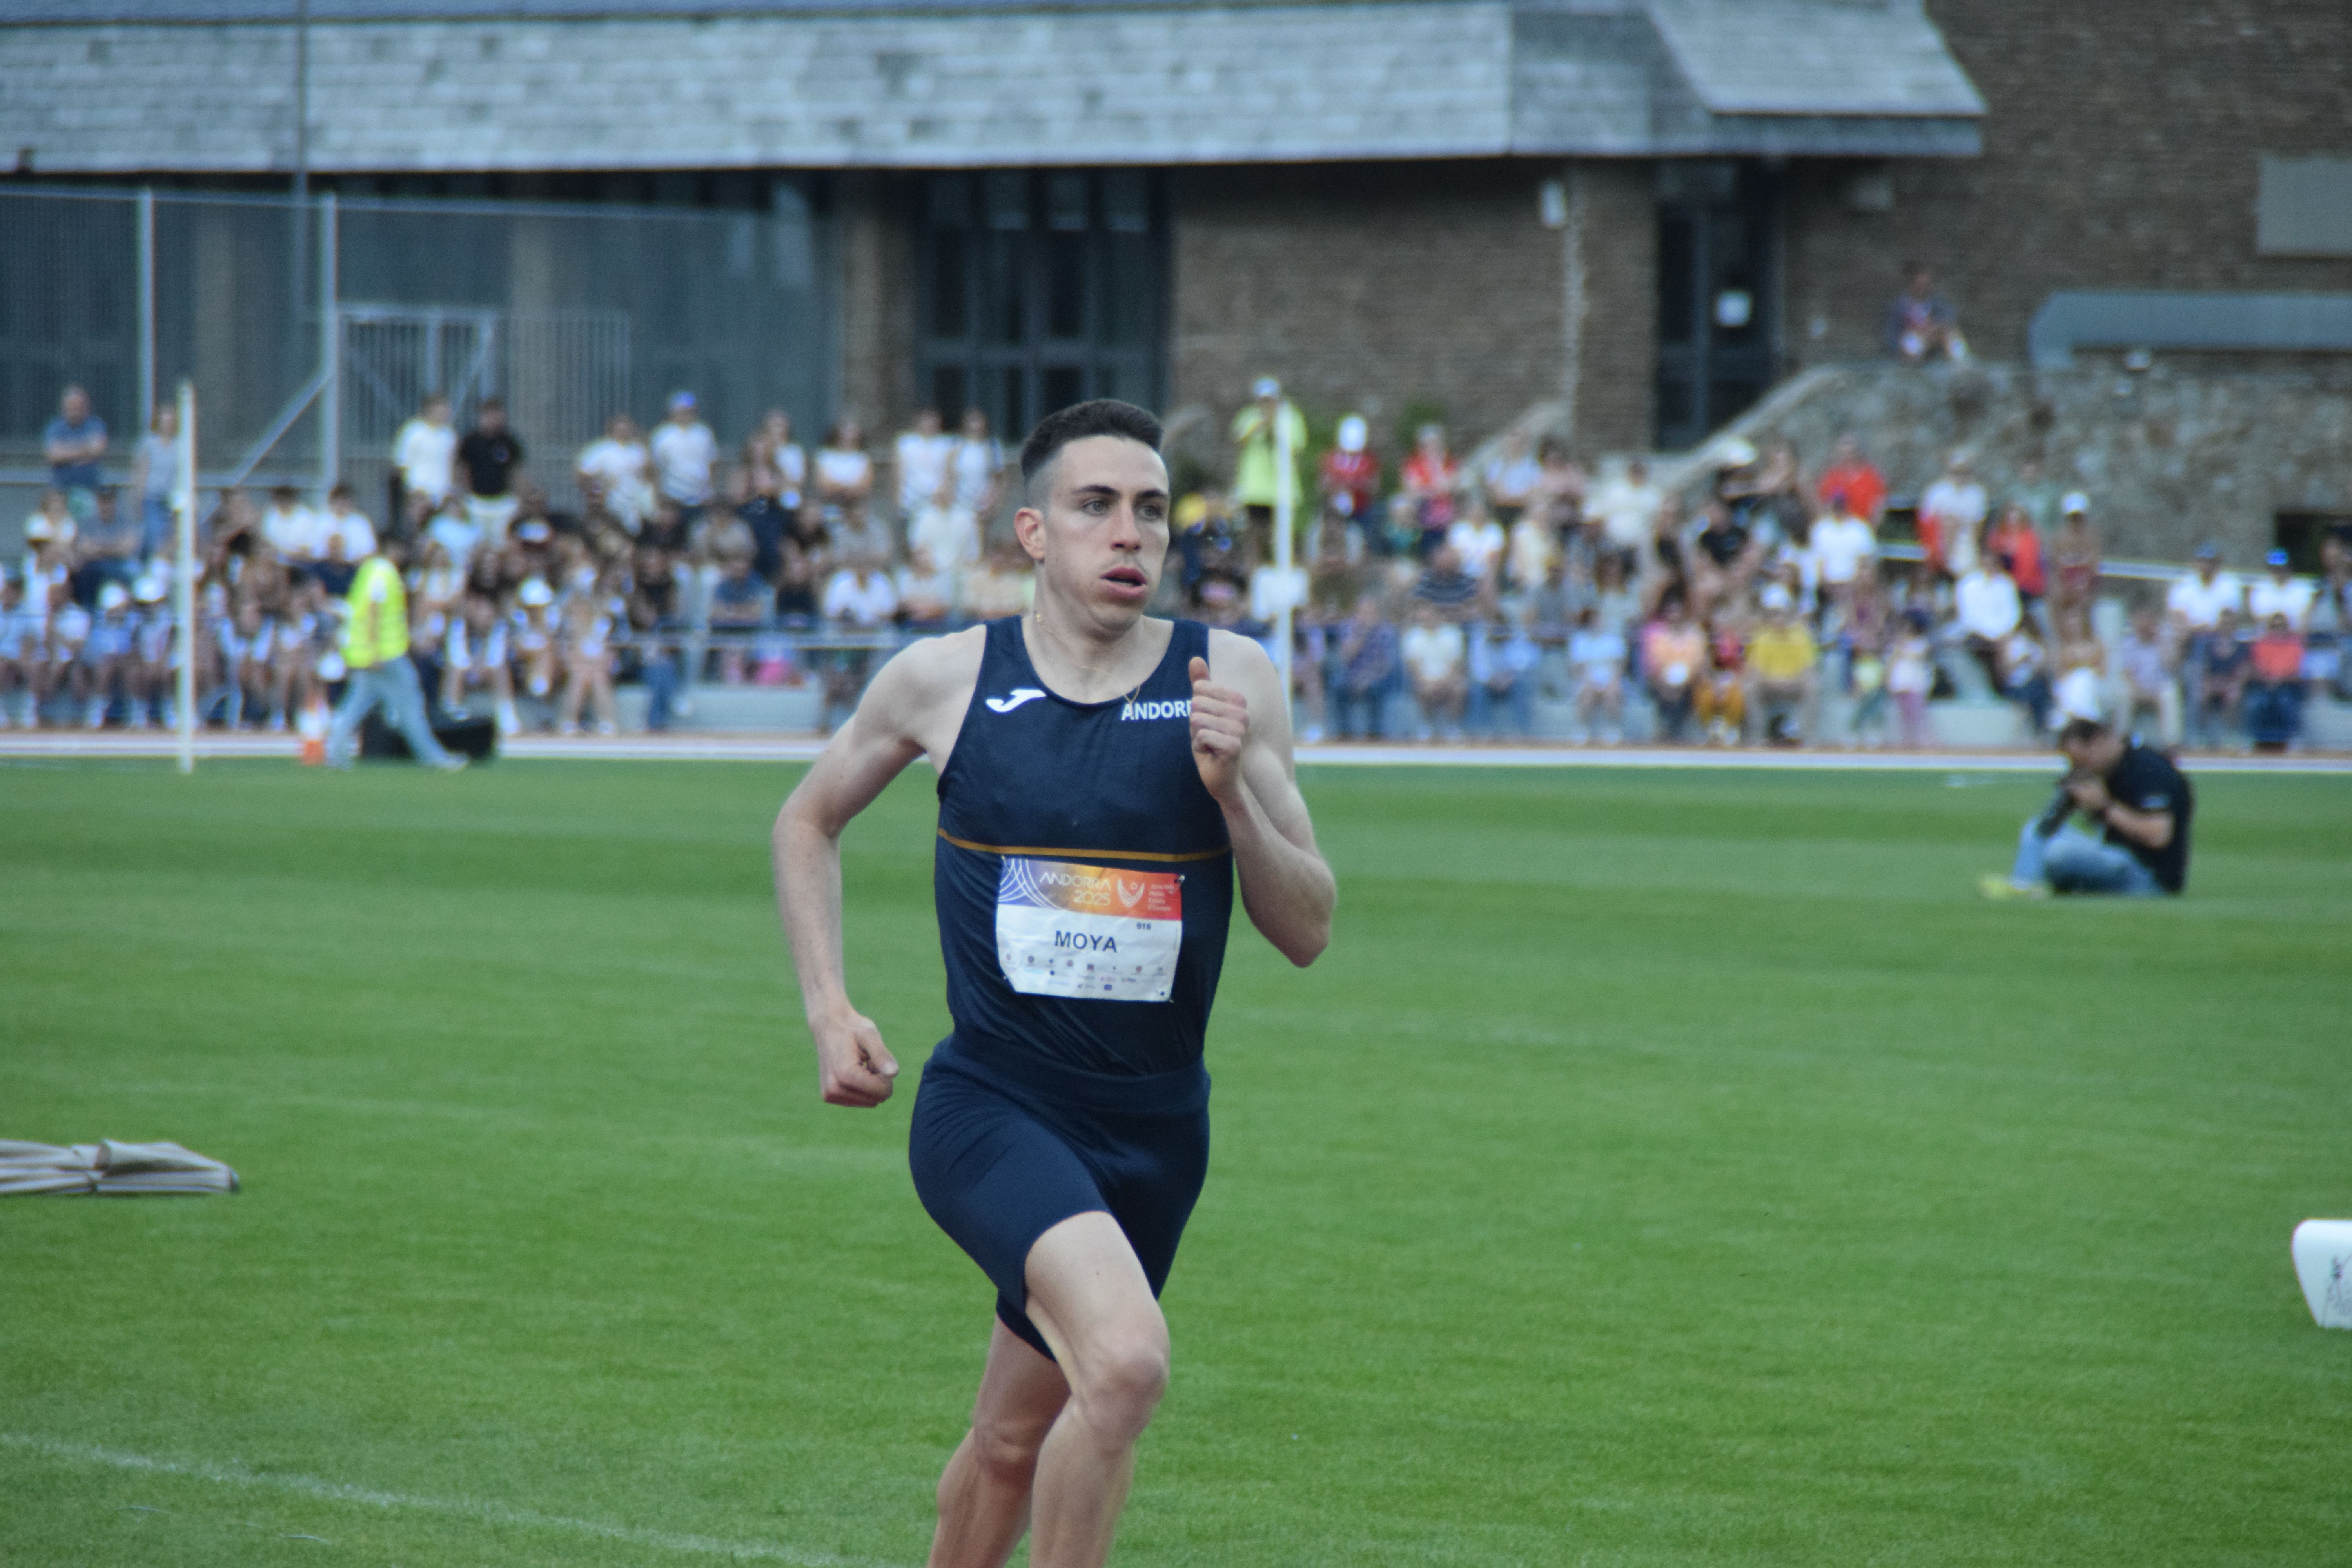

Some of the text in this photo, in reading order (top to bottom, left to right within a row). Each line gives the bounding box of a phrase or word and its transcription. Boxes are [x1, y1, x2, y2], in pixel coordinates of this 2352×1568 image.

[1040, 872, 1111, 891] ANDORRA
[1073, 889, 1111, 906] 2025
[1054, 930, 1117, 953] MOYA
